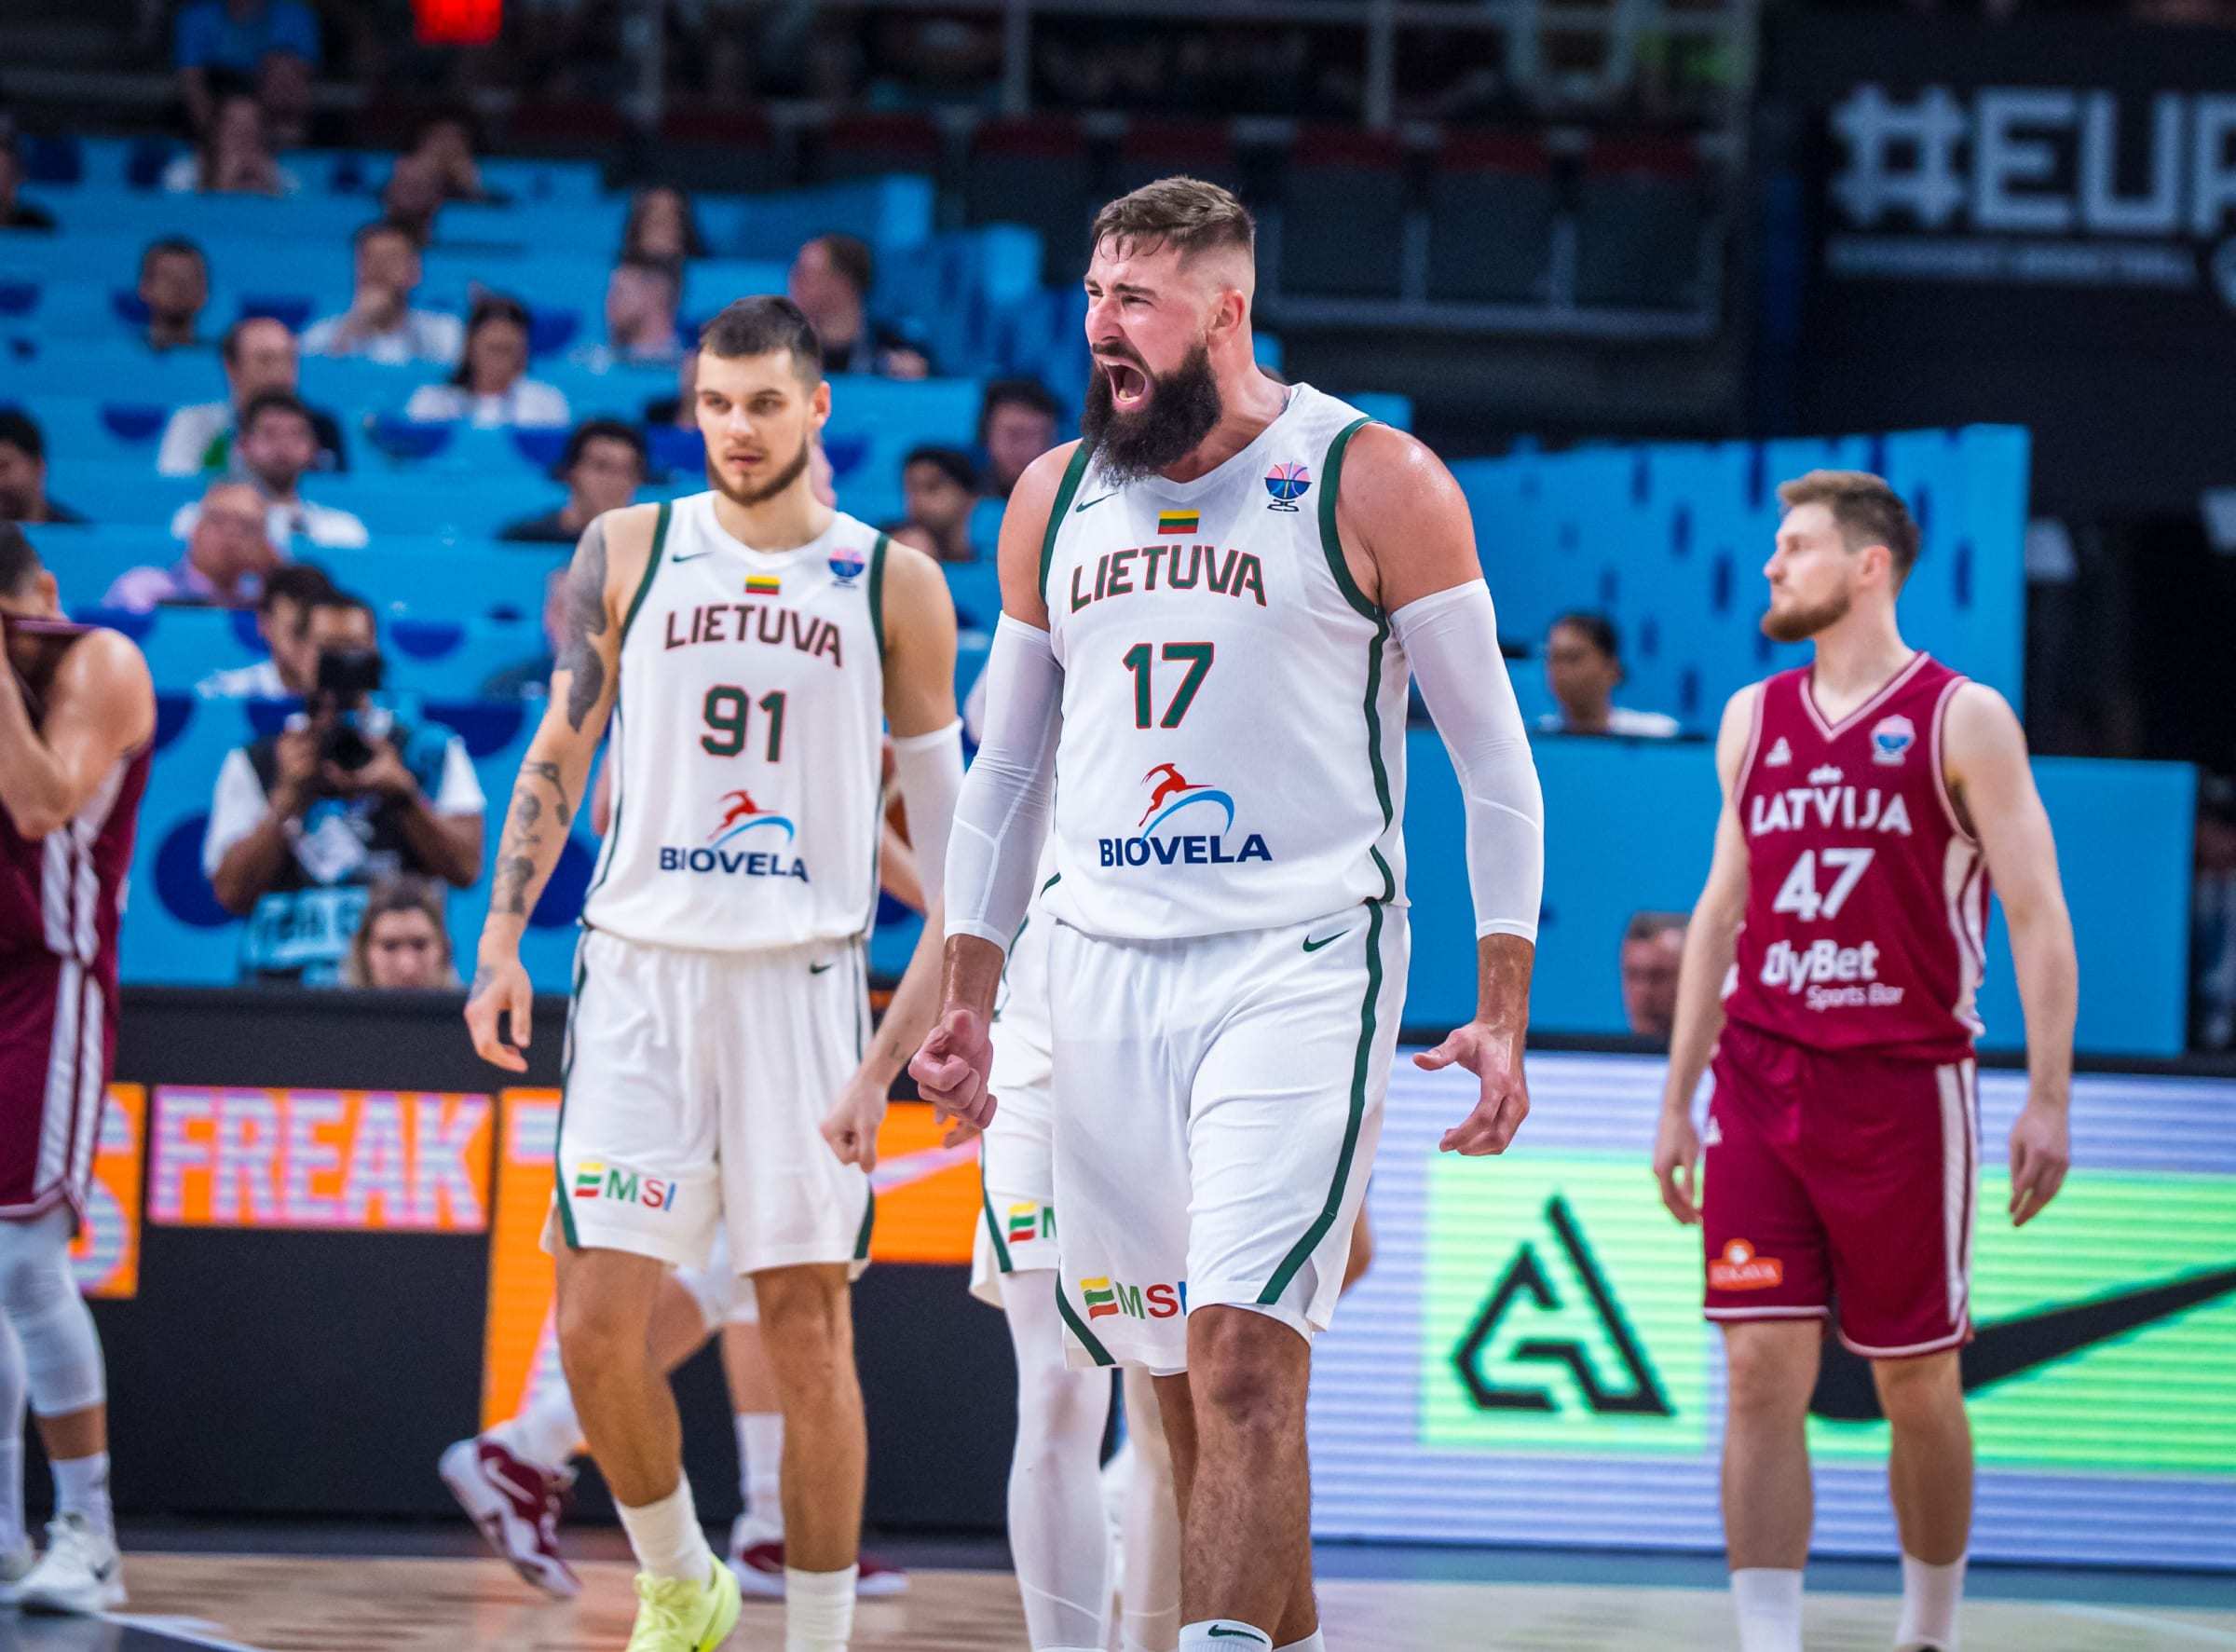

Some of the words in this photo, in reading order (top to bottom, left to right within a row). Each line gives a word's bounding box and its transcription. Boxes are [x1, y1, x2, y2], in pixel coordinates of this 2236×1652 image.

[1070, 544, 1268, 615] LIETUVA
[664, 604, 843, 667] LIETUVA
[1122, 641, 1215, 730] 17
[700, 683, 786, 762] 91
[1751, 785, 1913, 835] LATVIJA
[659, 845, 810, 881] BIOVELA
[1098, 833, 1274, 867] BIOVELA
[1773, 847, 1876, 922] 47
[152, 1085, 490, 1227] FREAK
